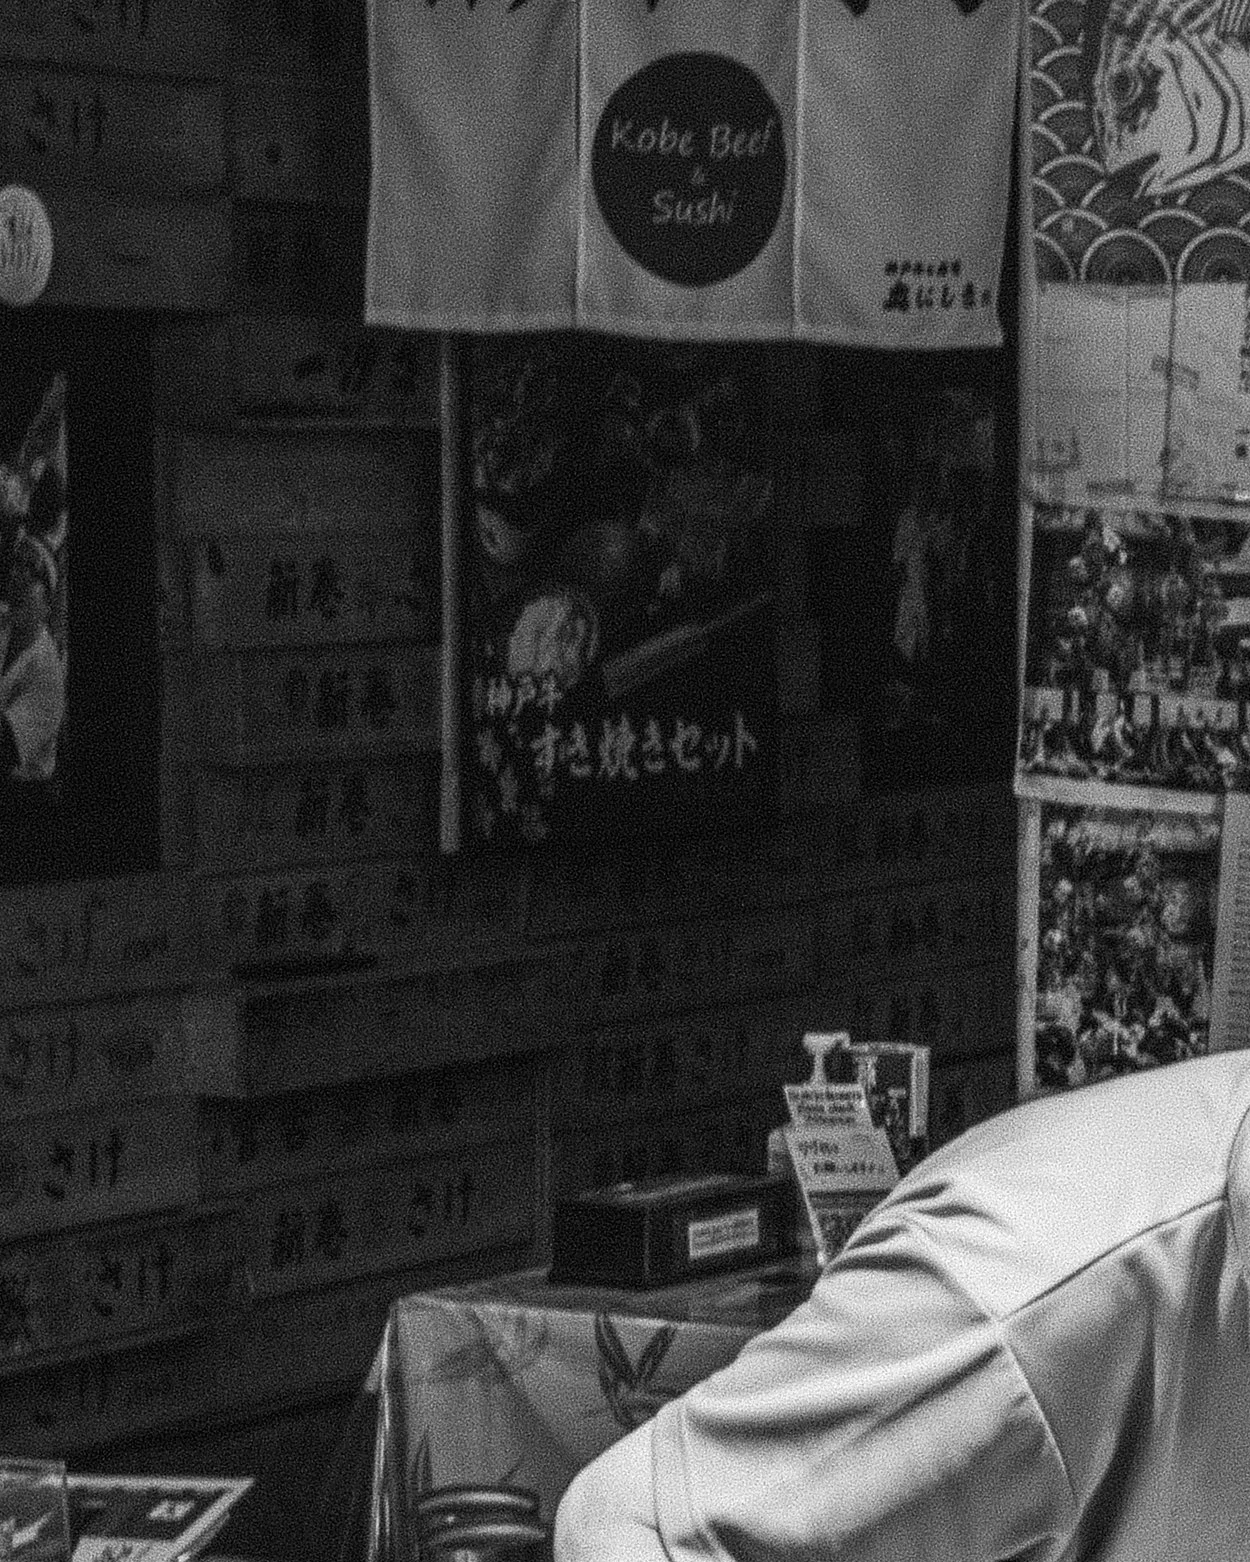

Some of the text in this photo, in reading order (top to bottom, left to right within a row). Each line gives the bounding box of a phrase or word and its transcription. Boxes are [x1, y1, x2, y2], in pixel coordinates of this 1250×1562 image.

[610, 117, 775, 158] Kobe Beef
[652, 188, 739, 224] Sushi
[529, 709, 758, 781] すき焼きセット
